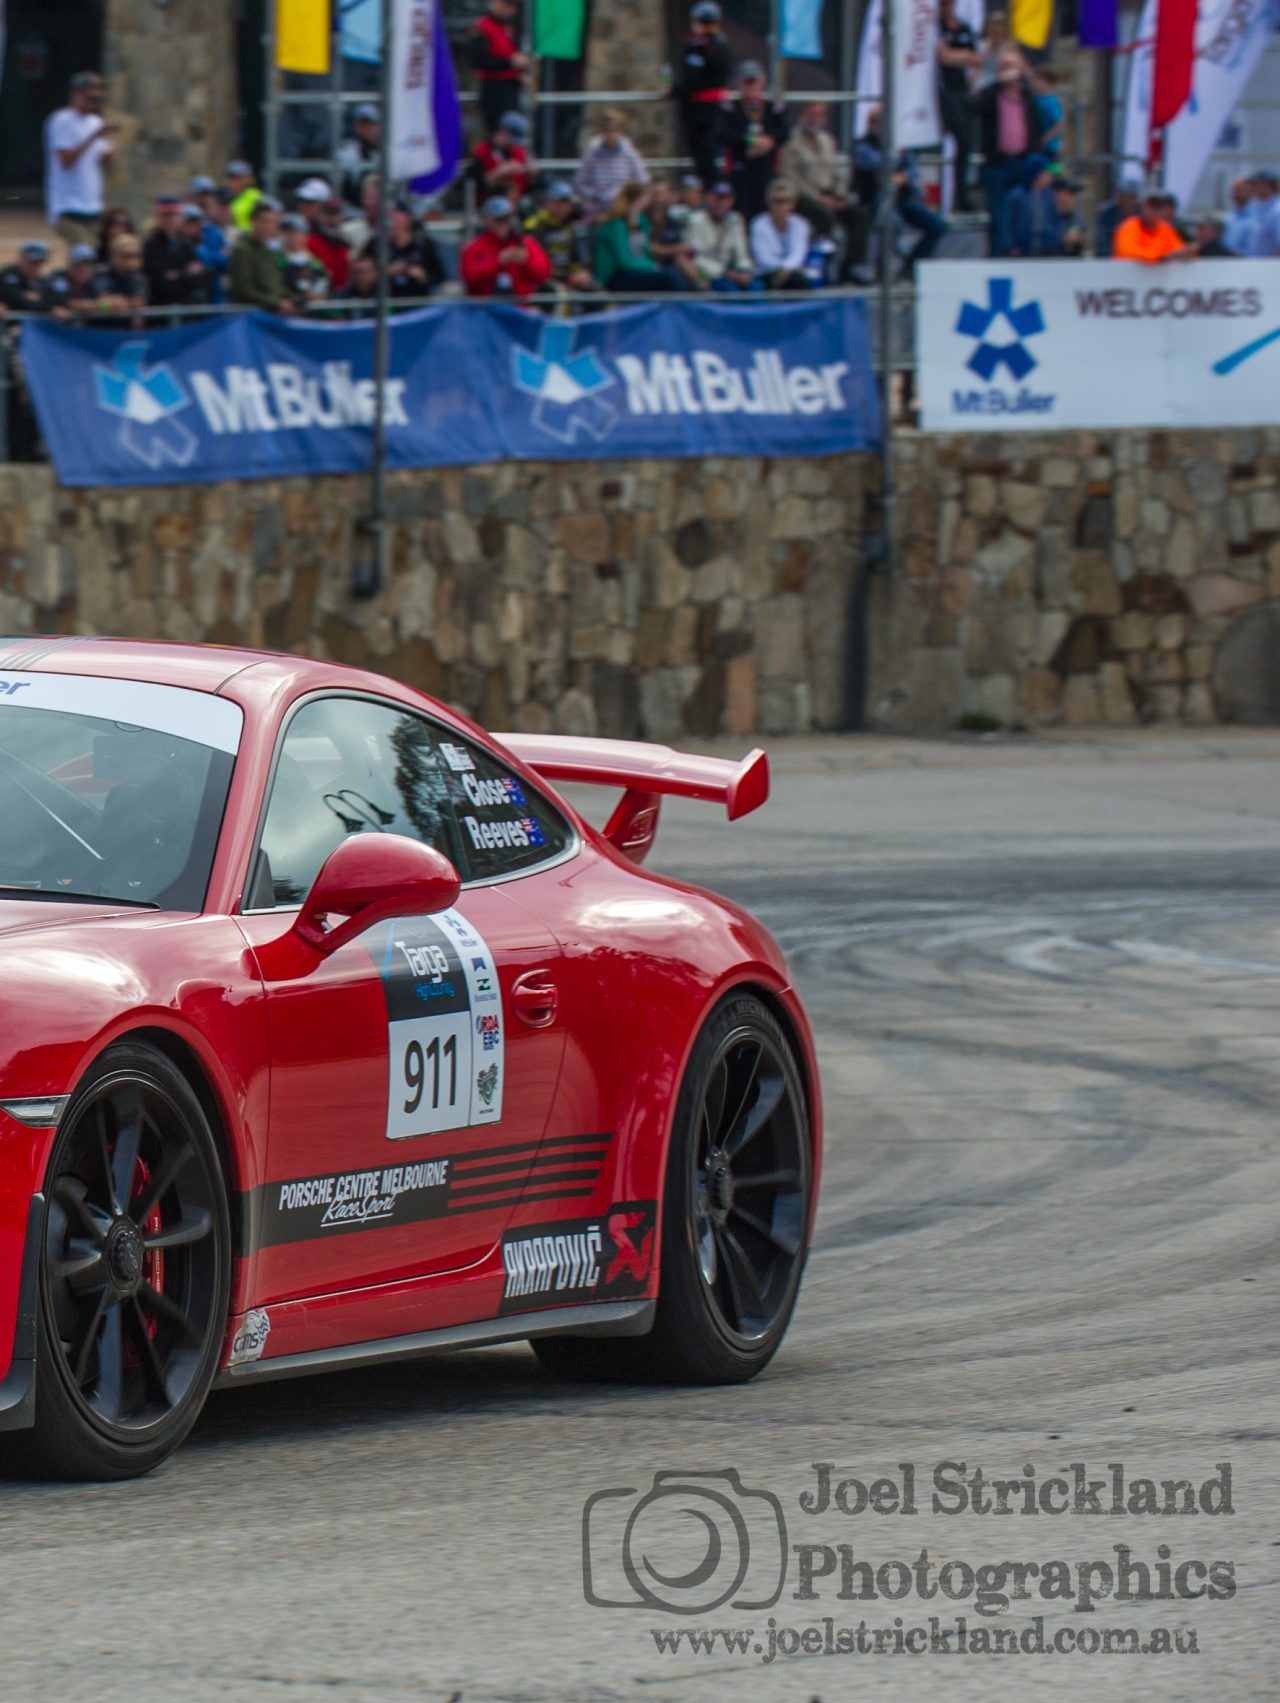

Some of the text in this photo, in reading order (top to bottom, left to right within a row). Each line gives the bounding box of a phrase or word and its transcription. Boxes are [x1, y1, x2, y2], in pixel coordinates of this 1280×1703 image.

[1076, 288, 1262, 318] WELCOMES
[461, 773, 511, 806] Close
[464, 816, 530, 849] Reeves
[394, 941, 450, 983] Targa
[403, 1034, 457, 1114] 911
[278, 1160, 449, 1210] PORSCHE CENTRE MELBOURNE
